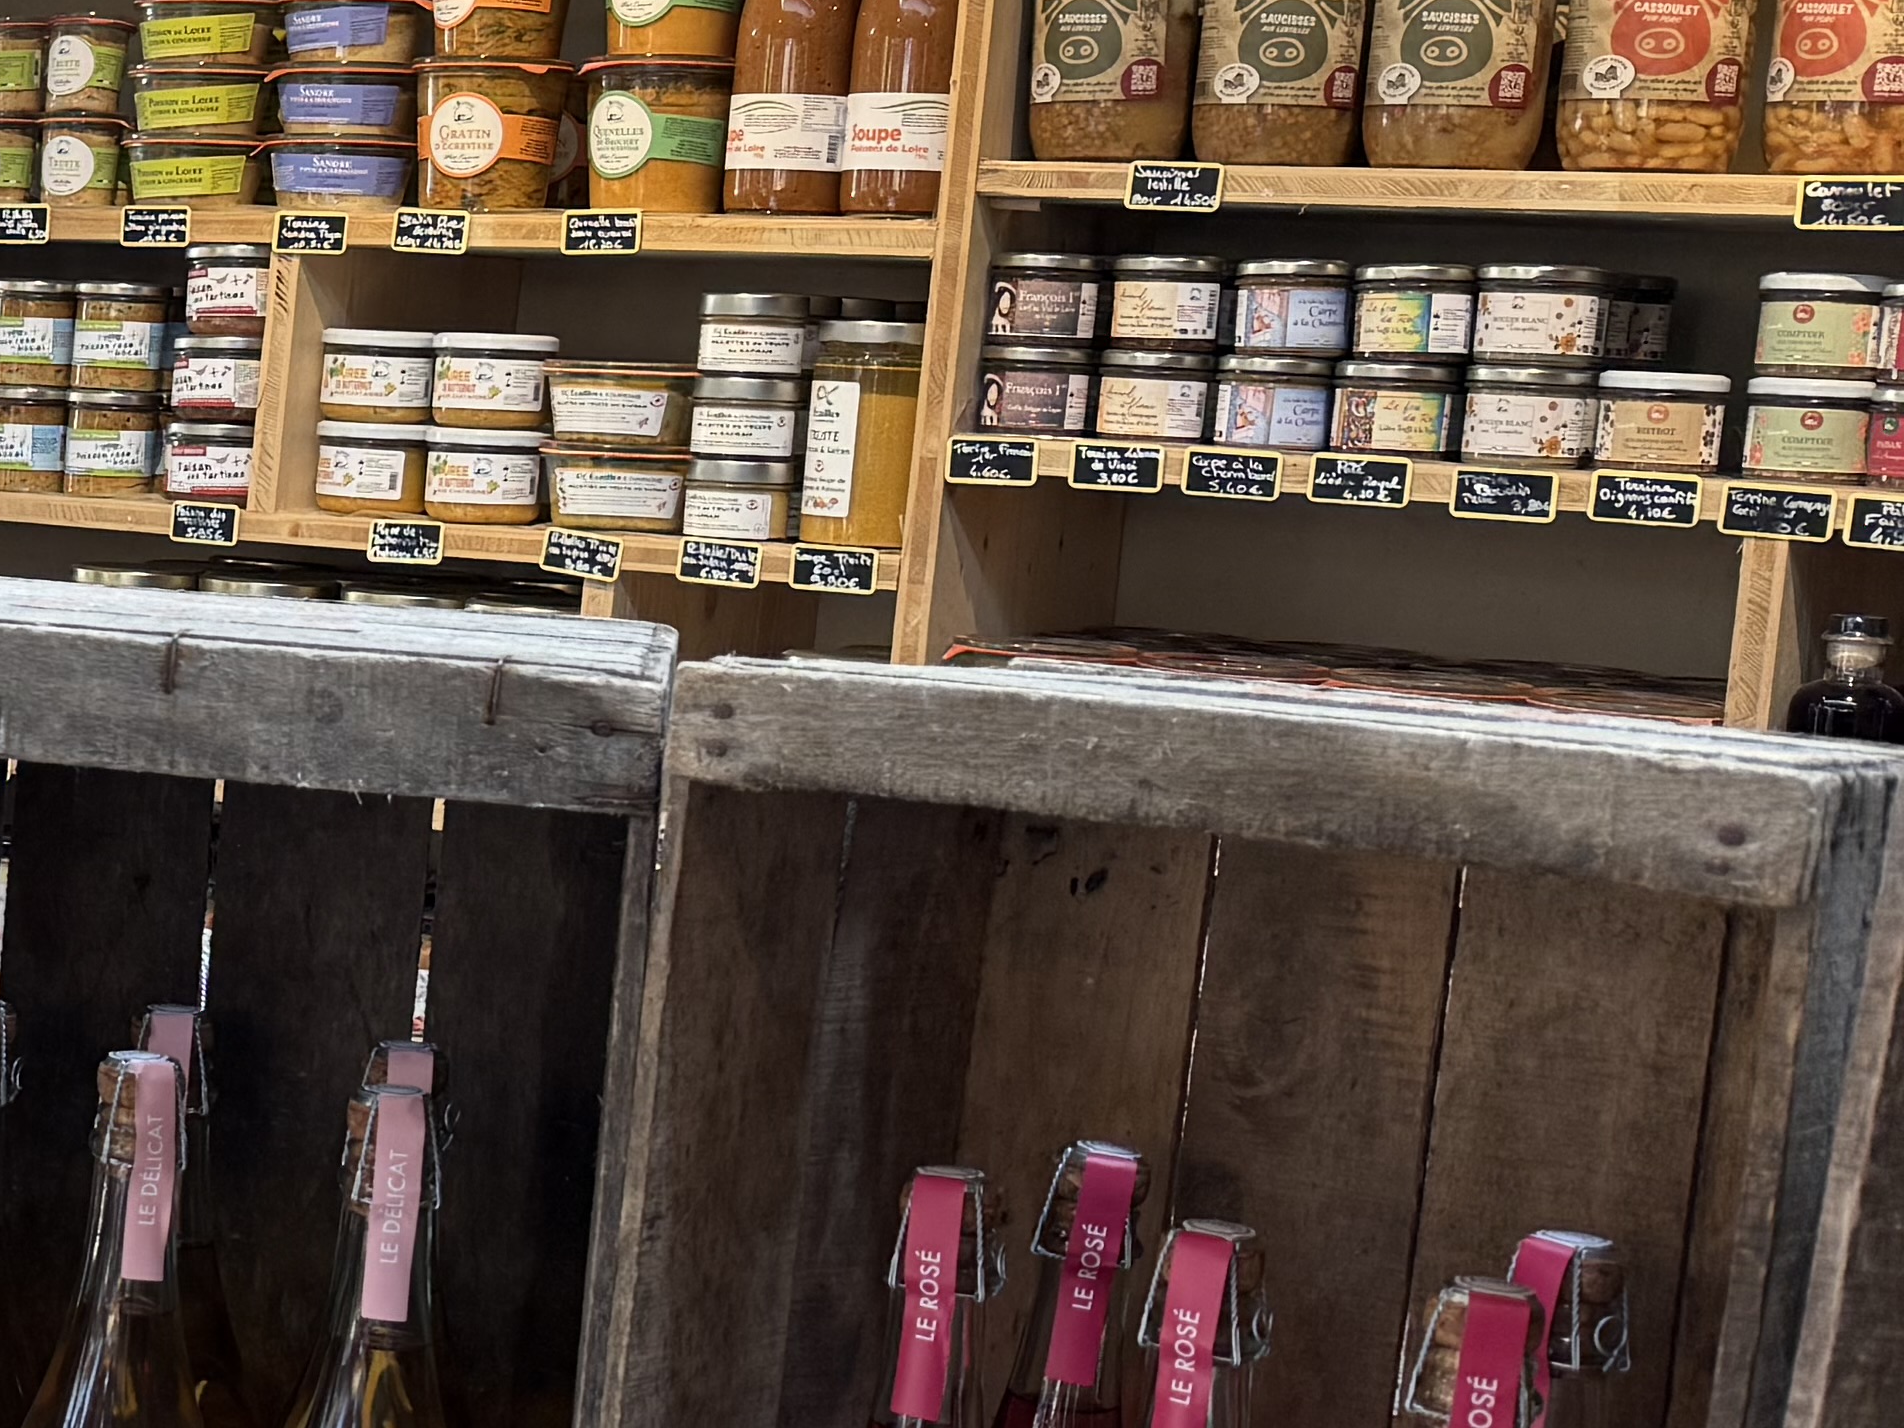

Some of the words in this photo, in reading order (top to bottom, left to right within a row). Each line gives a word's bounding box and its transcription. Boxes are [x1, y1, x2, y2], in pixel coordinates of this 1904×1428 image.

[1634, 1, 1700, 17] CASSOULET
[1796, 2, 1855, 16] CASSOULET
[1058, 13, 1108, 24] SAUCISSES
[1260, 13, 1316, 27] SAUCISSES
[1421, 10, 1479, 24] SAUCISSES
[184, 26, 212, 35] LOIRE
[192, 95, 219, 105] LOIRE
[439, 125, 492, 140] GRATIN
[593, 126, 644, 141] QUENELLES
[852, 124, 902, 144] Soupe
[902, 145, 929, 153] Loire
[175, 167, 203, 176] LOIRE
[1019, 289, 1066, 304] François
[1005, 382, 1052, 397] François
[139, 1115, 163, 1197] DÉLICAT
[379, 1150, 409, 1233] DÉLICAT
[138, 1203, 156, 1226] LE
[380, 1242, 398, 1264] LE
[1077, 1223, 1108, 1280] ROSÉ
[914, 1250, 942, 1311] ROSÉ
[1071, 1286, 1095, 1311] LE
[915, 1317, 937, 1342] LE
[1172, 1308, 1201, 1372] ROSÉ
[1168, 1379, 1193, 1406] LE
